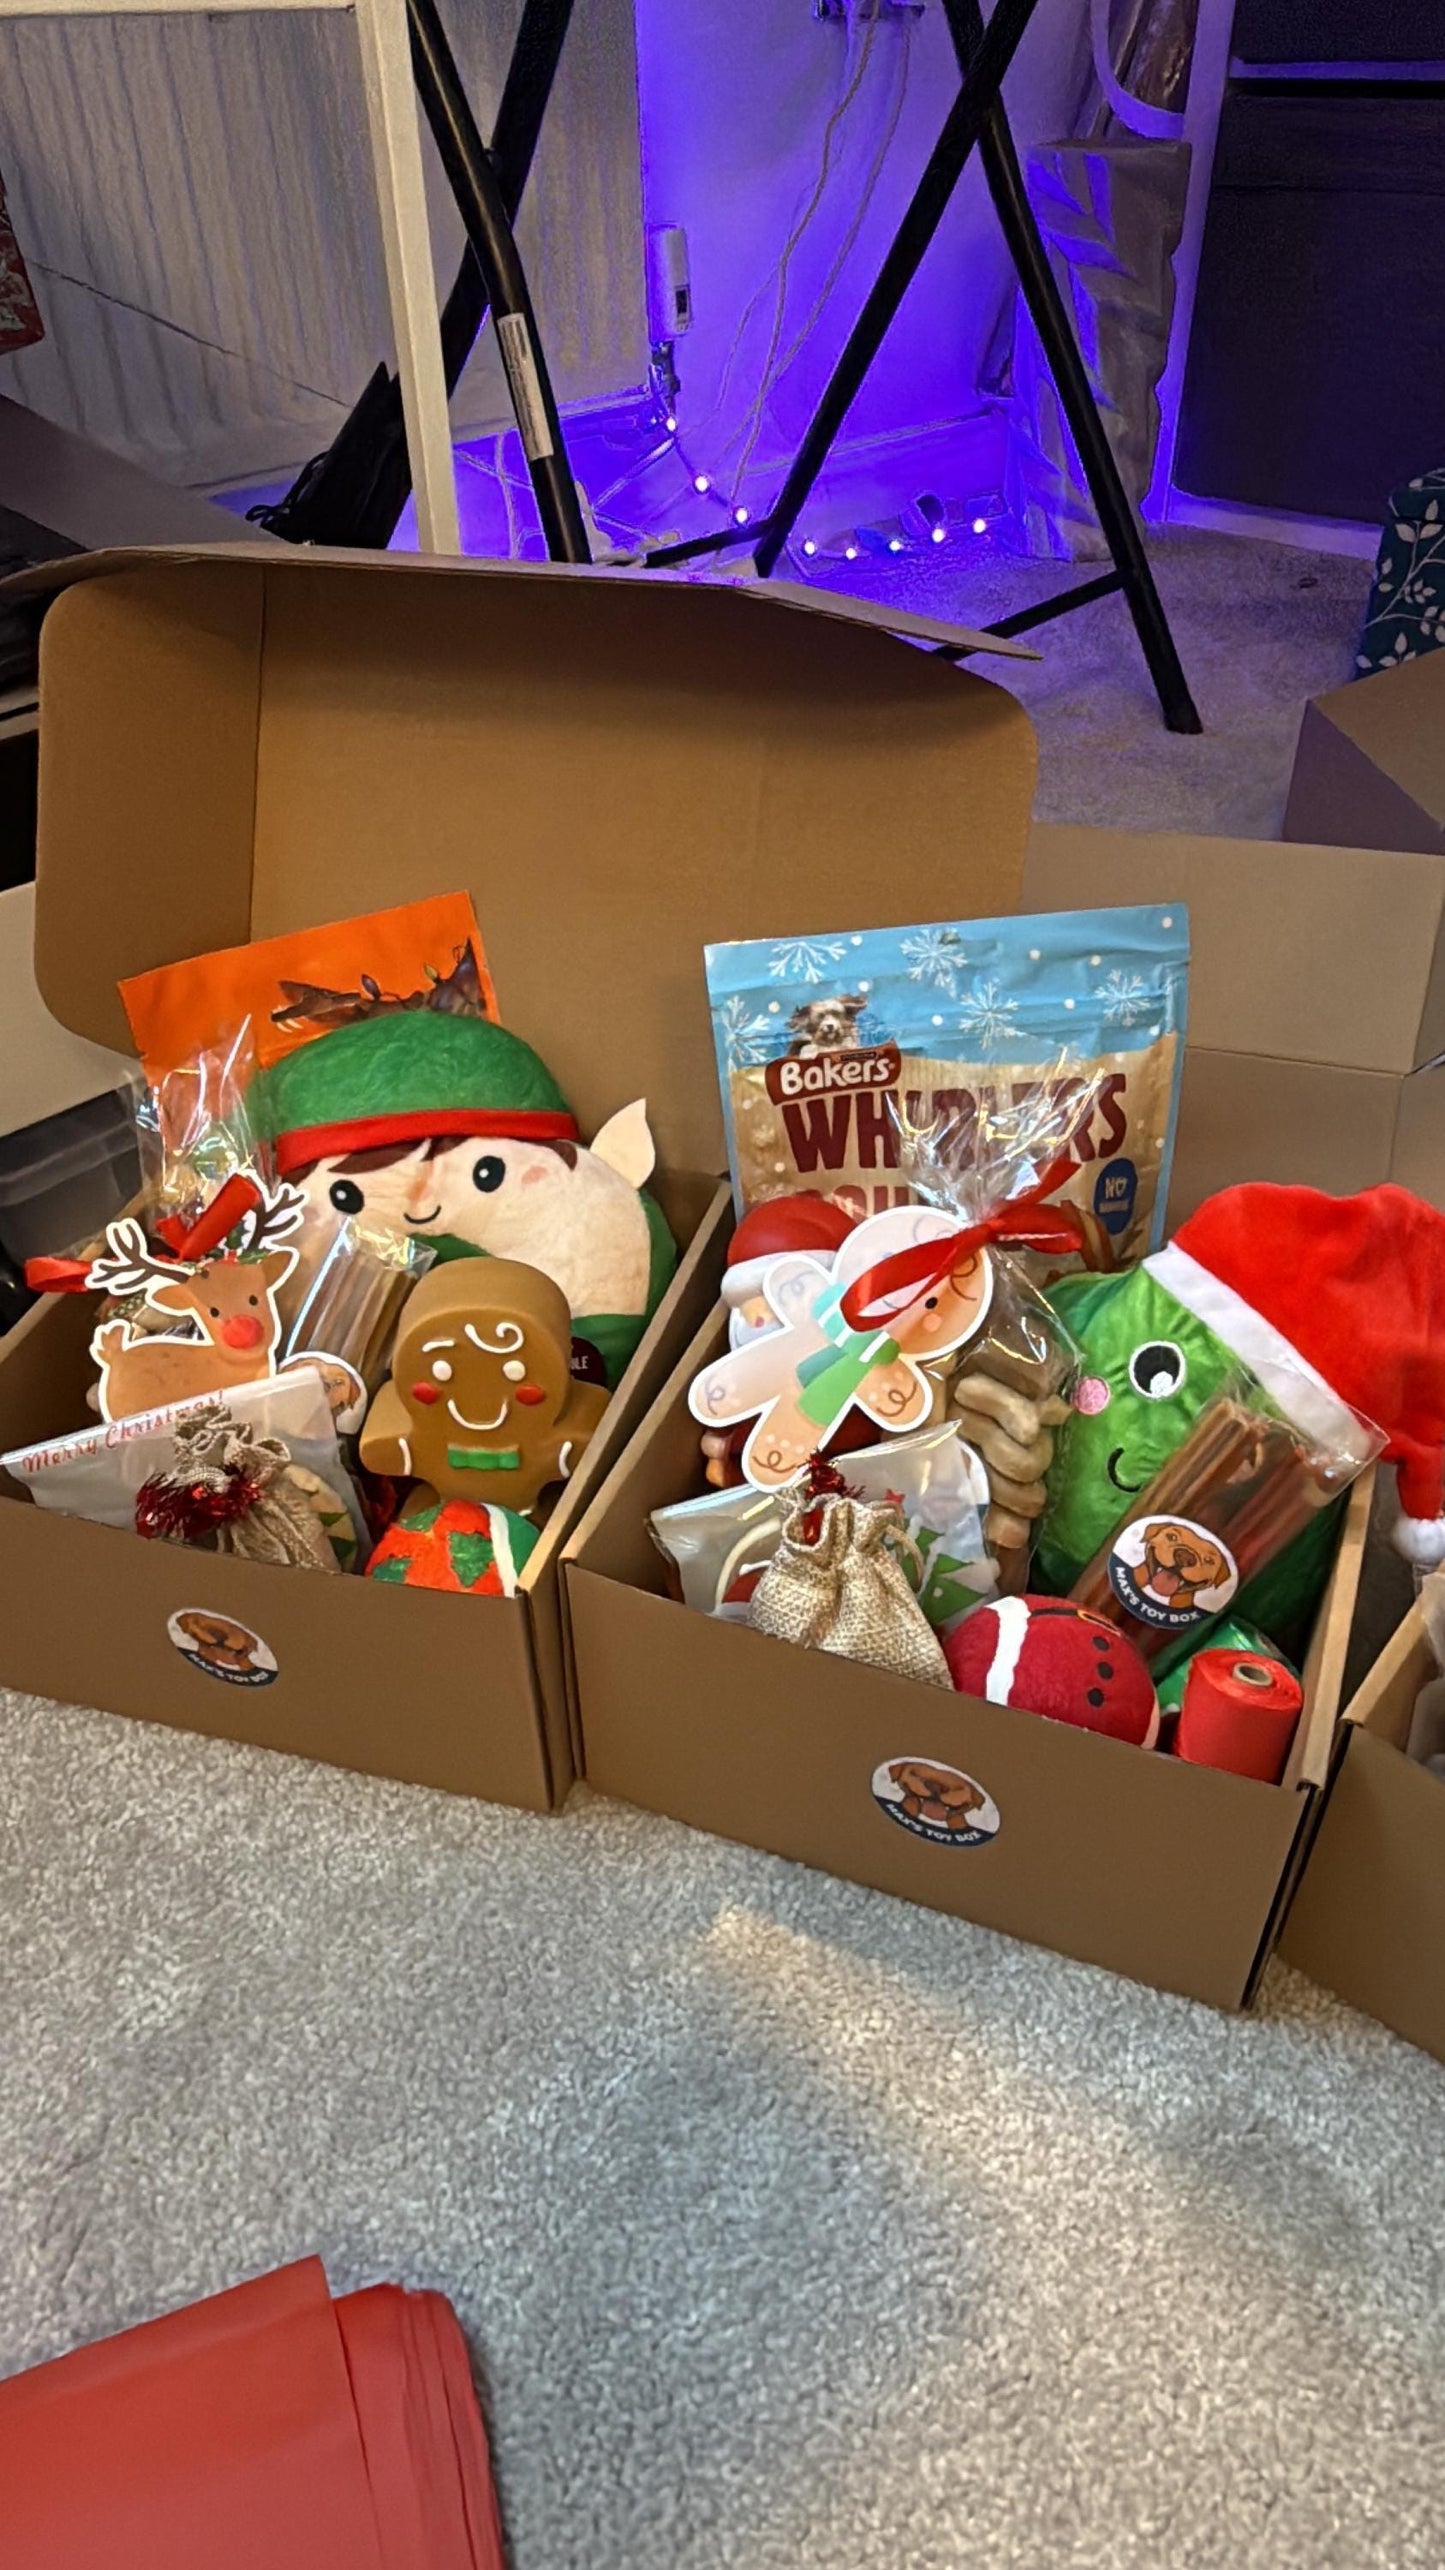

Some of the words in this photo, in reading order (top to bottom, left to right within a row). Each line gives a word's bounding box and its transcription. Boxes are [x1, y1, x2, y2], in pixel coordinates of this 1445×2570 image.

[780, 1058, 890, 1095] Bakers
[23, 1439, 98, 1473] Merry
[1115, 1566, 1140, 1606] MAX'S
[1140, 1603, 1166, 1621] TOY
[1169, 1611, 1201, 1623] BOX
[886, 1803, 923, 1832] MAX'S
[925, 1830, 953, 1842] TOY
[955, 1830, 983, 1843] BOX
